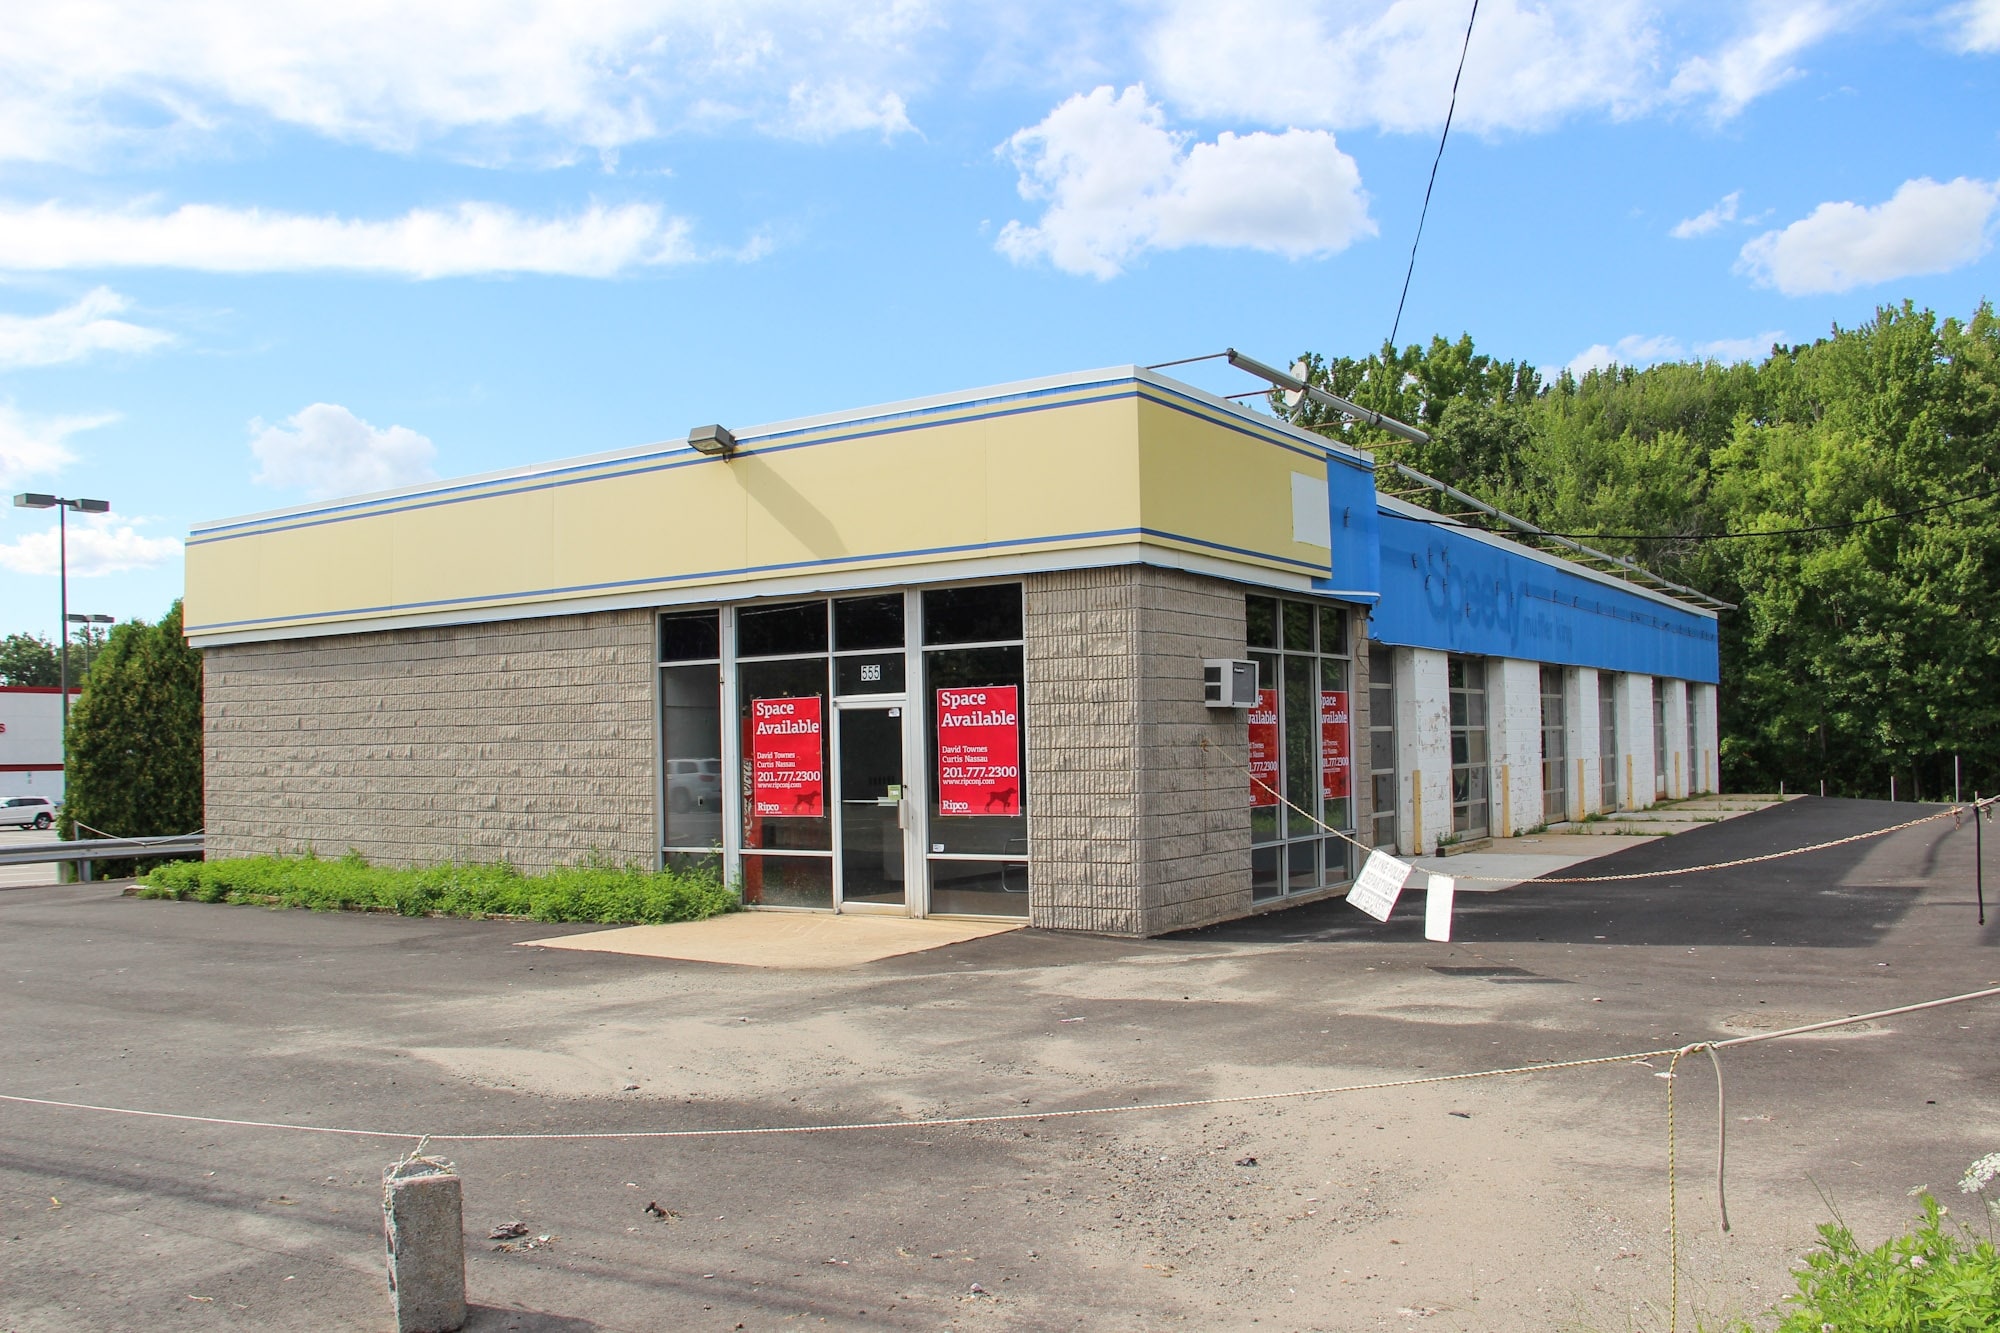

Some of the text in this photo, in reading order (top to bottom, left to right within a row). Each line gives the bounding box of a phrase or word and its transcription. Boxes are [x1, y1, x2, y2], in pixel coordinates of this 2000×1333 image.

[862, 666, 879, 680] 555
[941, 691, 986, 709] Space
[1322, 696, 1336, 709] pace
[756, 702, 794, 718] Space
[941, 710, 1015, 727] Available
[1248, 711, 1277, 724] vailable
[756, 719, 819, 735] Available
[942, 755, 989, 763] Curtis Nassau
[942, 766, 1018, 778] 201.777.2300
[1248, 762, 1278, 772] 1.777.2300
[757, 771, 821, 782] 201.777.2300
[942, 778, 995, 786] www.ripconj.com
[757, 802, 780, 814] Ripco
[942, 800, 969, 813] Ripco
